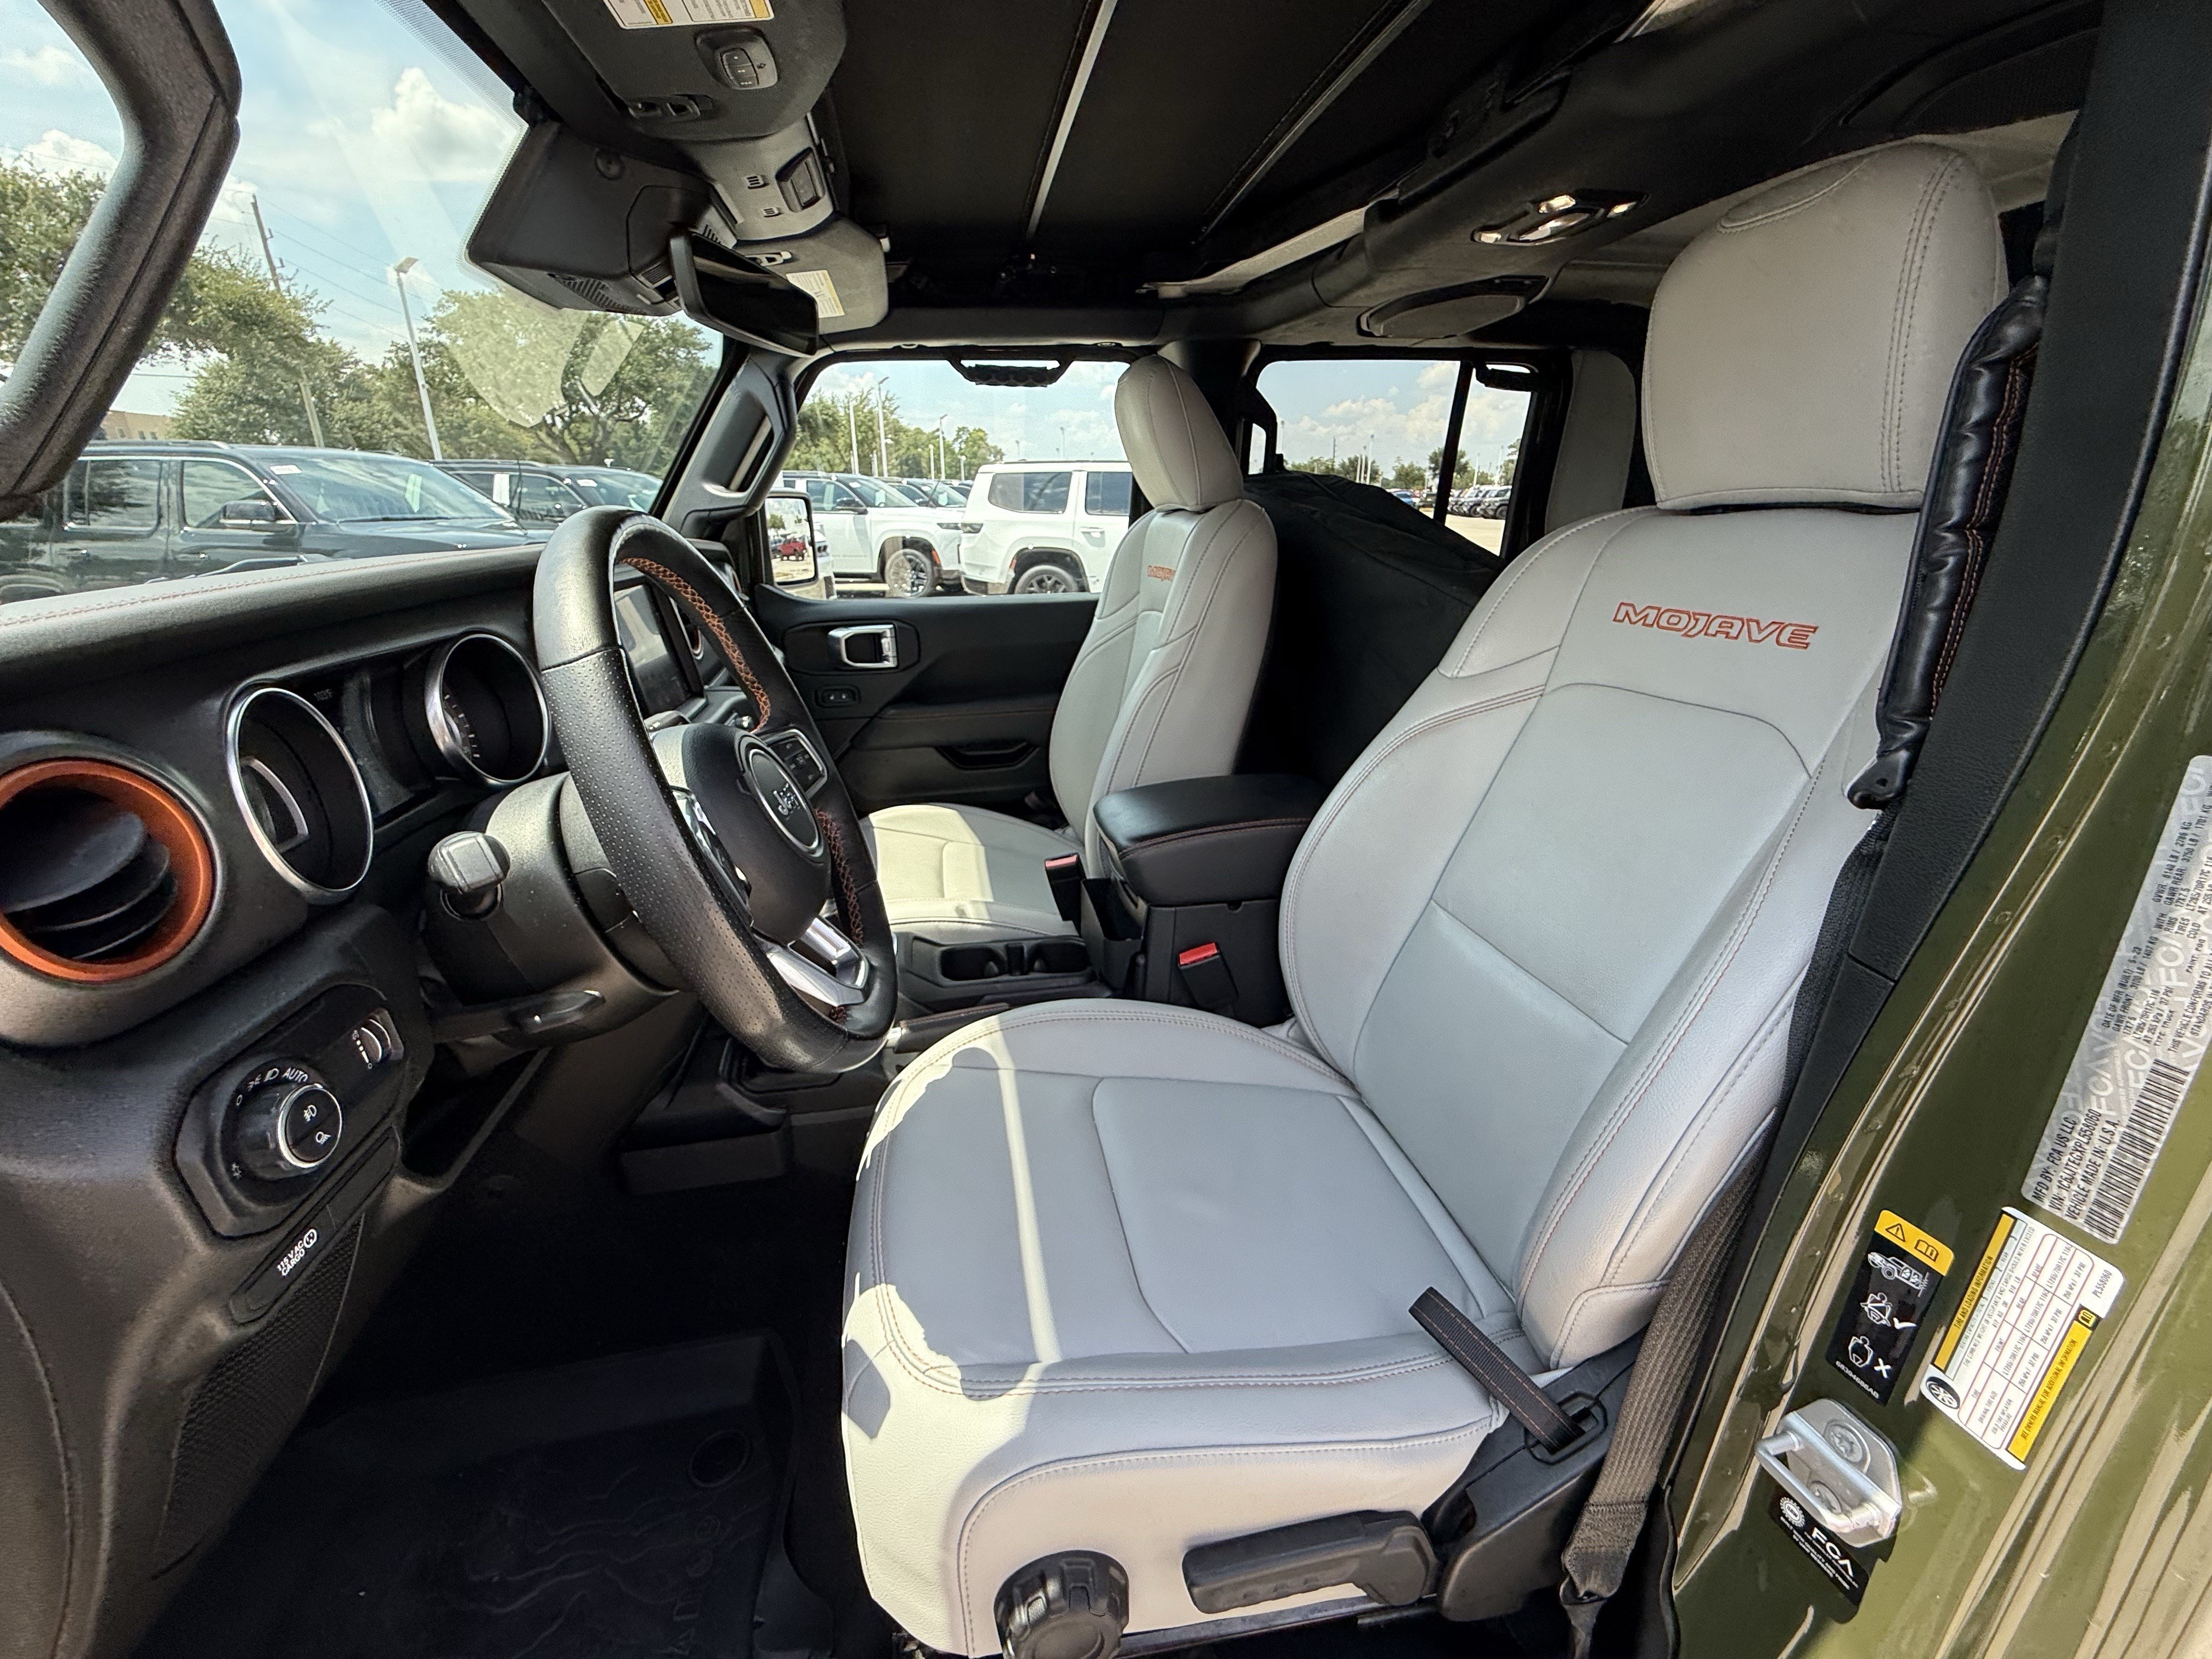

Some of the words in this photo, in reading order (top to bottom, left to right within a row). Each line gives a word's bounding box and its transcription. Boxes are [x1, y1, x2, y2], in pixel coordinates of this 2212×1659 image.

[1612, 602, 1819, 650] MOJAVE
[2179, 819, 2192, 832] KG
[2147, 934, 2159, 945] KG
[2162, 884, 2179, 906] GAWR
[2174, 916, 2191, 937] TIRES
[2142, 1035, 2153, 1045] AT
[2162, 985, 2175, 998] PSI
[2186, 921, 2201, 940] COLD
[2198, 969, 2211, 980] TO
[2183, 979, 2208, 1015] CONFORMS
[2107, 1003, 2119, 1013] OF
[2188, 997, 2212, 1037] STANDARDS
[2101, 1011, 2115, 1028] DATE
[2173, 1012, 2192, 1040] VEHICLE
[2166, 1037, 2181, 1054] THIS
[282, 1067, 309, 1082] AUTO
[2058, 1115, 2077, 1135] LLC
[2097, 1115, 2120, 1146] U.S.A.
[2053, 1133, 2070, 1148] US
[2055, 1107, 2102, 1193] 1C6JJTEGXPL558060
[2046, 1147, 2064, 1166] FCA
[2090, 1143, 2108, 1160] IN:
[2039, 1165, 2056, 1182] BY:
[2079, 1158, 2102, 1186] MADE
[2031, 1181, 2050, 1202] MFD
[2047, 1191, 2067, 1211] VIN:
[2064, 1183, 2091, 1221] VEHICLE
[276, 1256, 290, 1271] 115
[280, 1248, 306, 1277] CARGO
[2000, 1272, 2013, 1287] CARGO
[2022, 1226, 2035, 1244] EXCEED
[1972, 1254, 1994, 1289] INFORMATION
[2091, 1268, 2112, 1298] PL558060
[1962, 1286, 1979, 1308] LOADING
[1953, 1316, 1965, 1329] TIRE
[1957, 1306, 1969, 1318] AND
[2056, 1338, 2077, 1368] INFORMATION
[2045, 1366, 2062, 1391] ADDITIONAL
[2040, 1389, 2051, 1400] FOR
[2032, 1398, 2046, 1416] MANUAL
[1811, 1526, 1852, 1577] FCA
